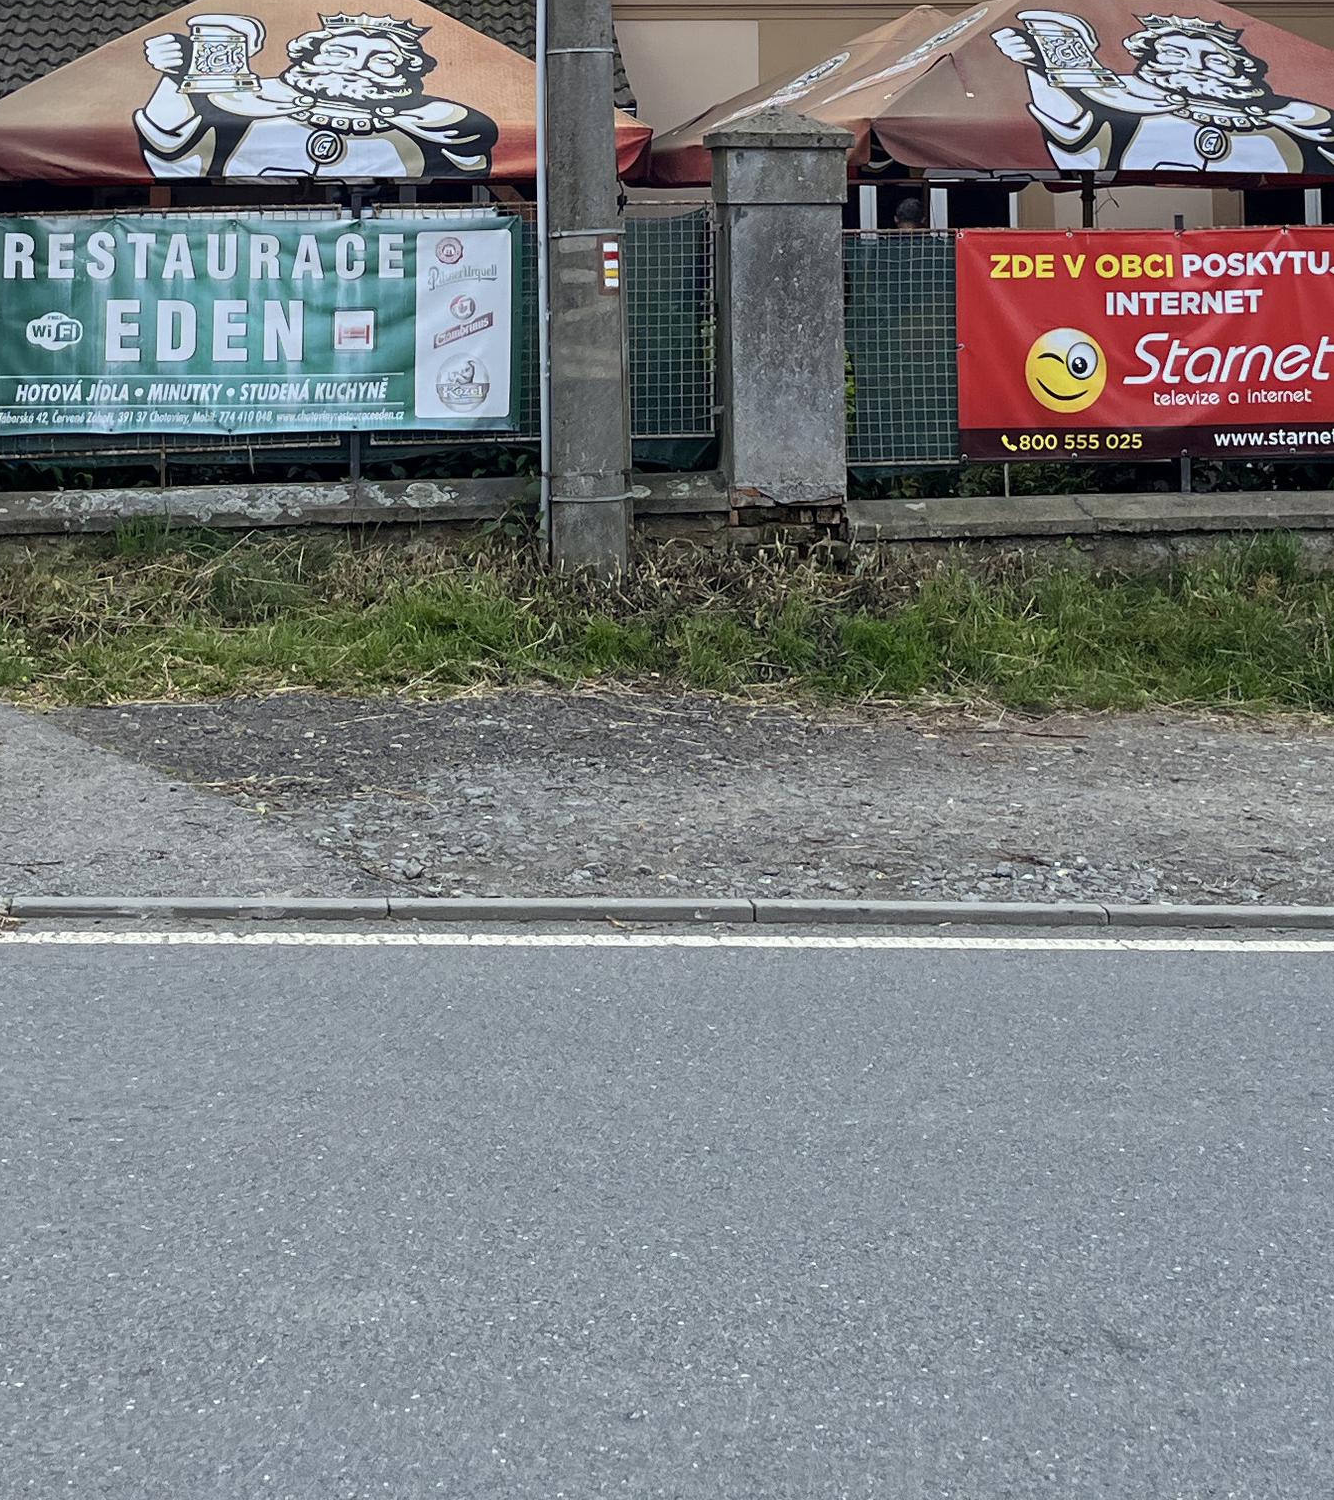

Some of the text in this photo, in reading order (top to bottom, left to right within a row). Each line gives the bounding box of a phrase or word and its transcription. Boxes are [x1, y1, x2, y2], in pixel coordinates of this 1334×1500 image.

[3, 232, 405, 280] RESTAURACE
[990, 254, 1055, 279] ZDE
[1063, 254, 1086, 279] V
[1095, 253, 1174, 279] OBCI
[1106, 289, 1263, 316] INTERNET
[105, 299, 304, 363] EDEN
[15, 377, 389, 402] HOTOVÁ JÍDLA MINUTKY STUDENÁ KUCHYNĚ
[442, 385, 484, 399] Kozel
[1153, 388, 1312, 406] televize a internet
[1019, 433, 1143, 450] 800 555 025
